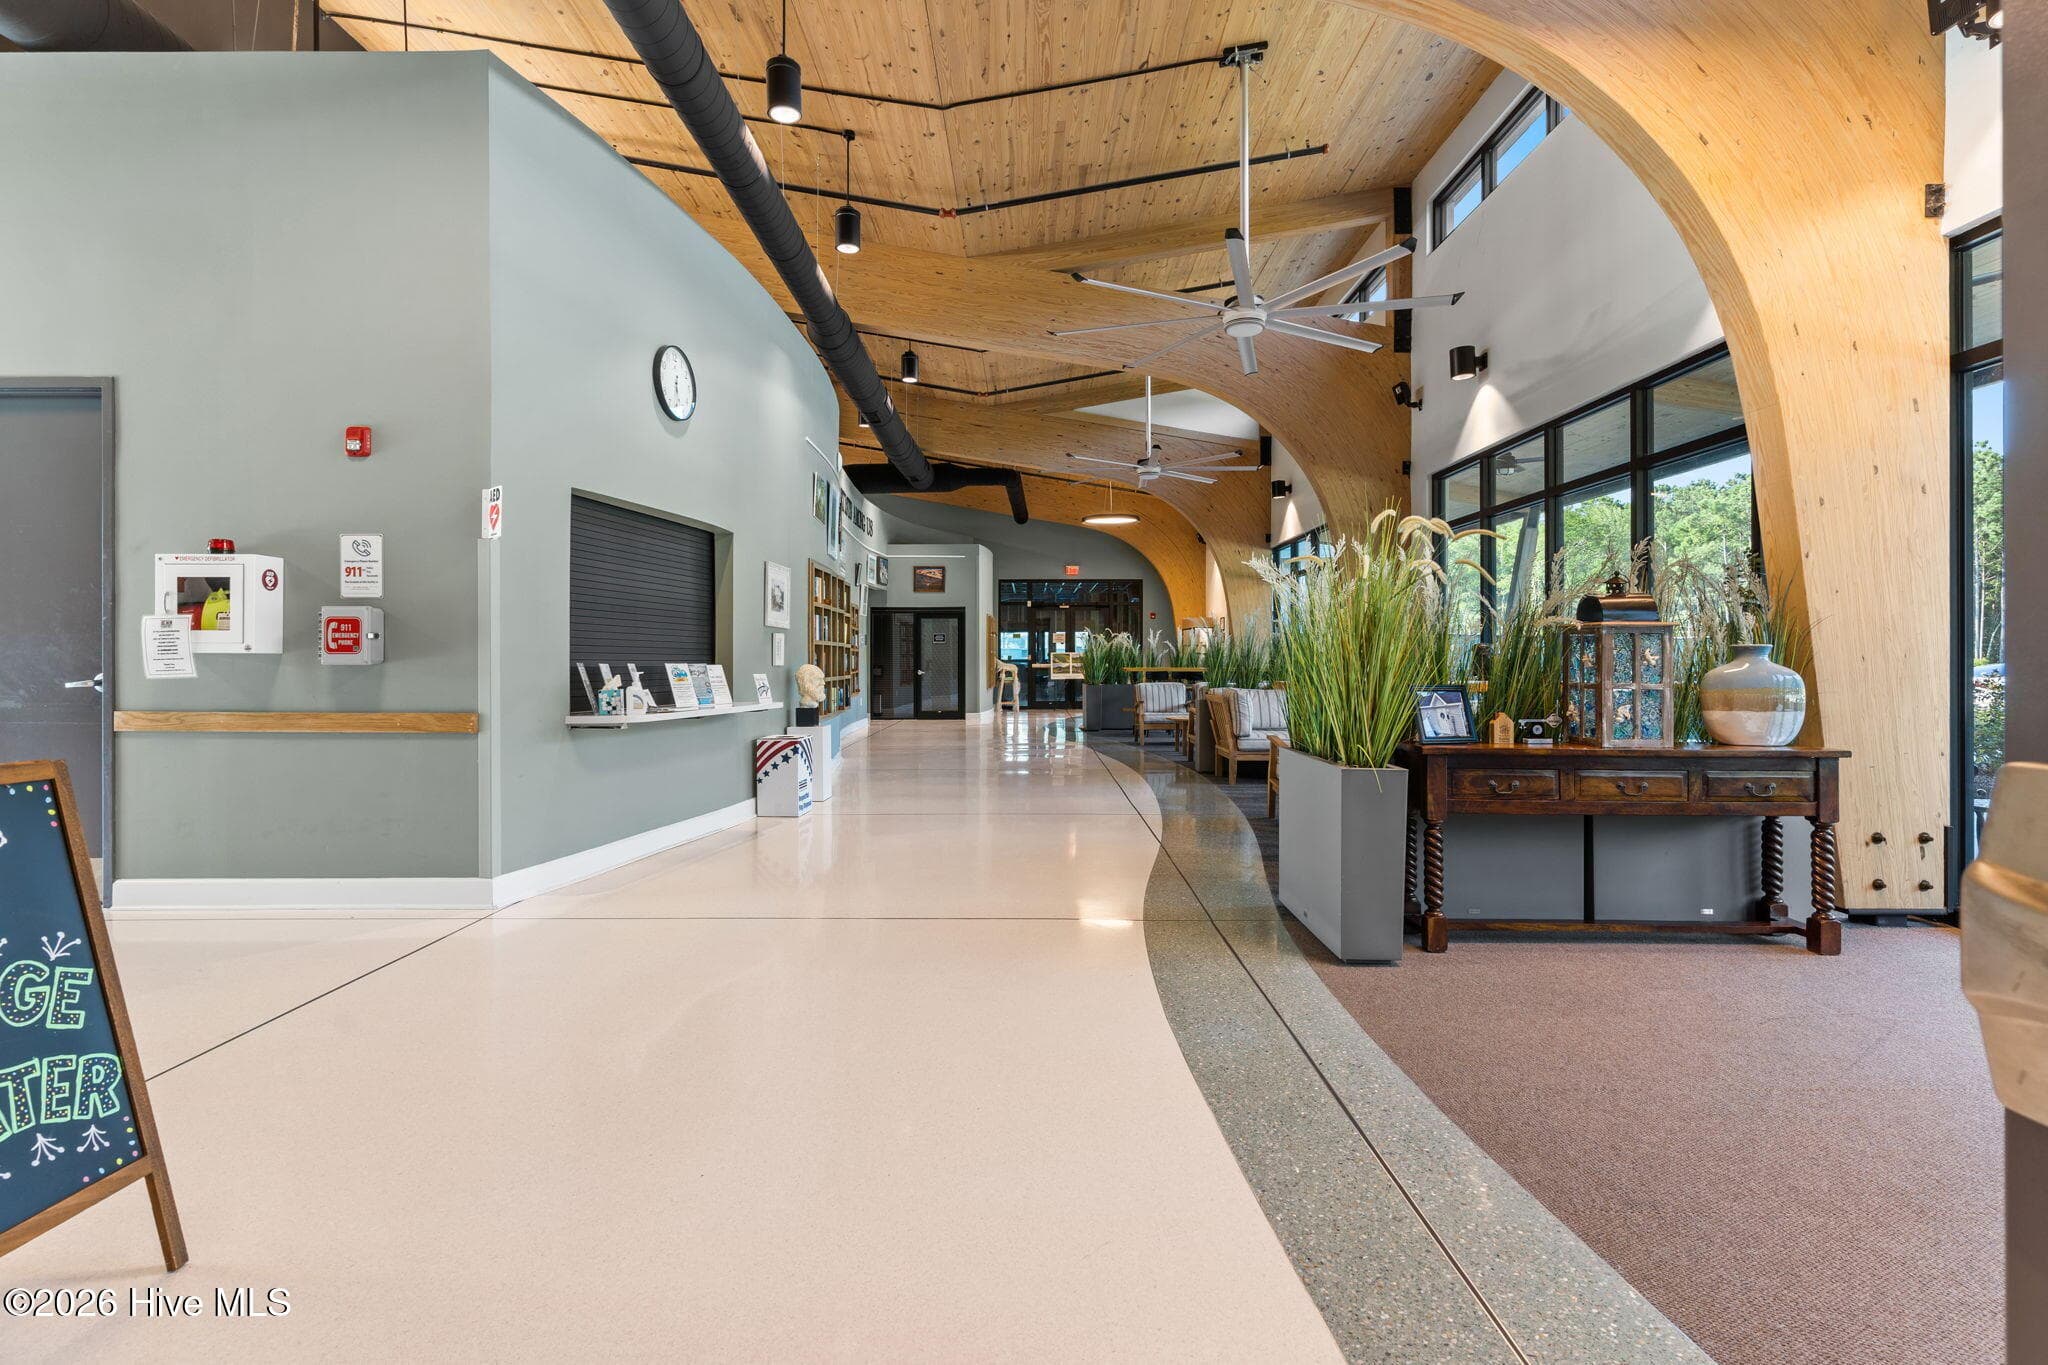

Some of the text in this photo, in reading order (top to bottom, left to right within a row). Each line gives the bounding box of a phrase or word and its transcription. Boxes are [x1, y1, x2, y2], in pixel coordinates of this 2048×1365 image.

[490, 488, 500, 502] AED
[866, 517, 874, 537] US
[345, 566, 362, 577] 911
[340, 623, 352, 631] 911
